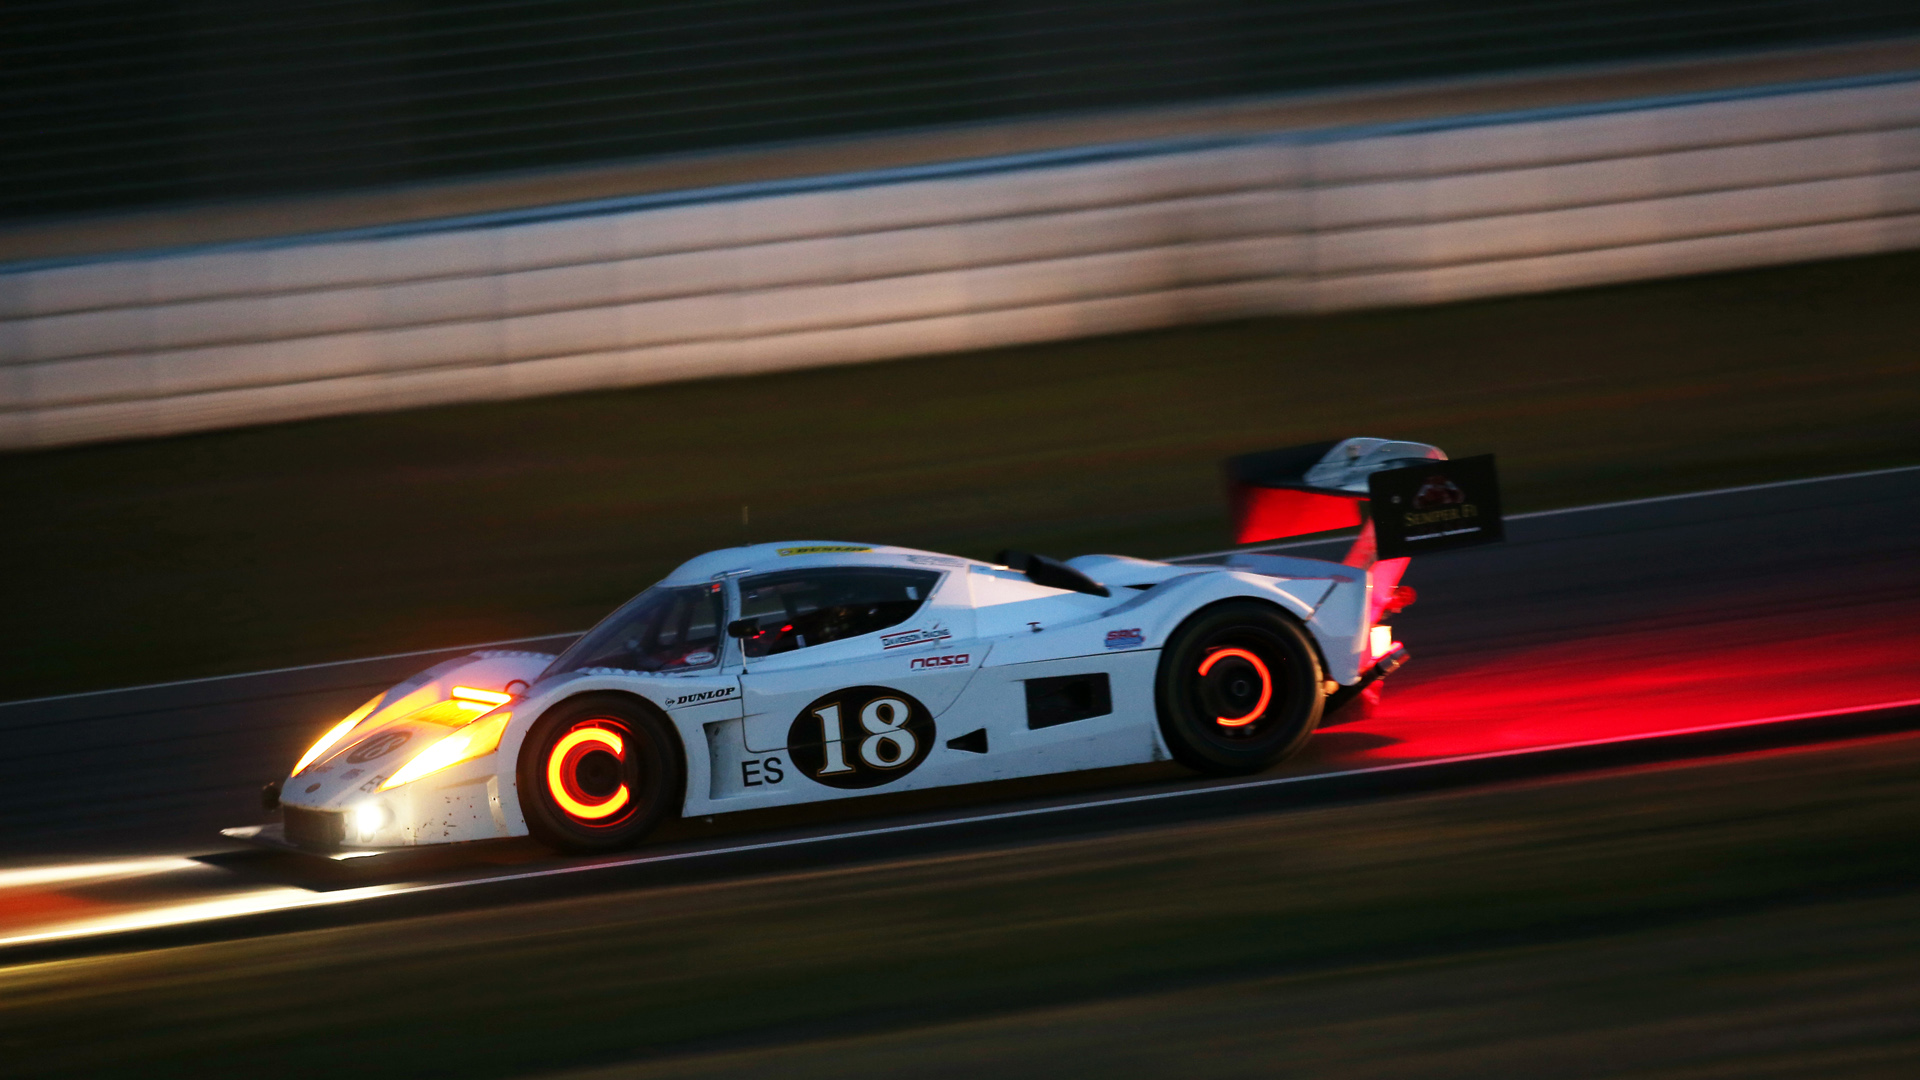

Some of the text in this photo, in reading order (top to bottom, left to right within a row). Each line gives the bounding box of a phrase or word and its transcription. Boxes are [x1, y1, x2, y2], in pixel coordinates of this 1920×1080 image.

[910, 654, 970, 669] nasa
[677, 687, 735, 704] DUNLOP
[811, 696, 918, 777] 18
[741, 757, 784, 787] ES
